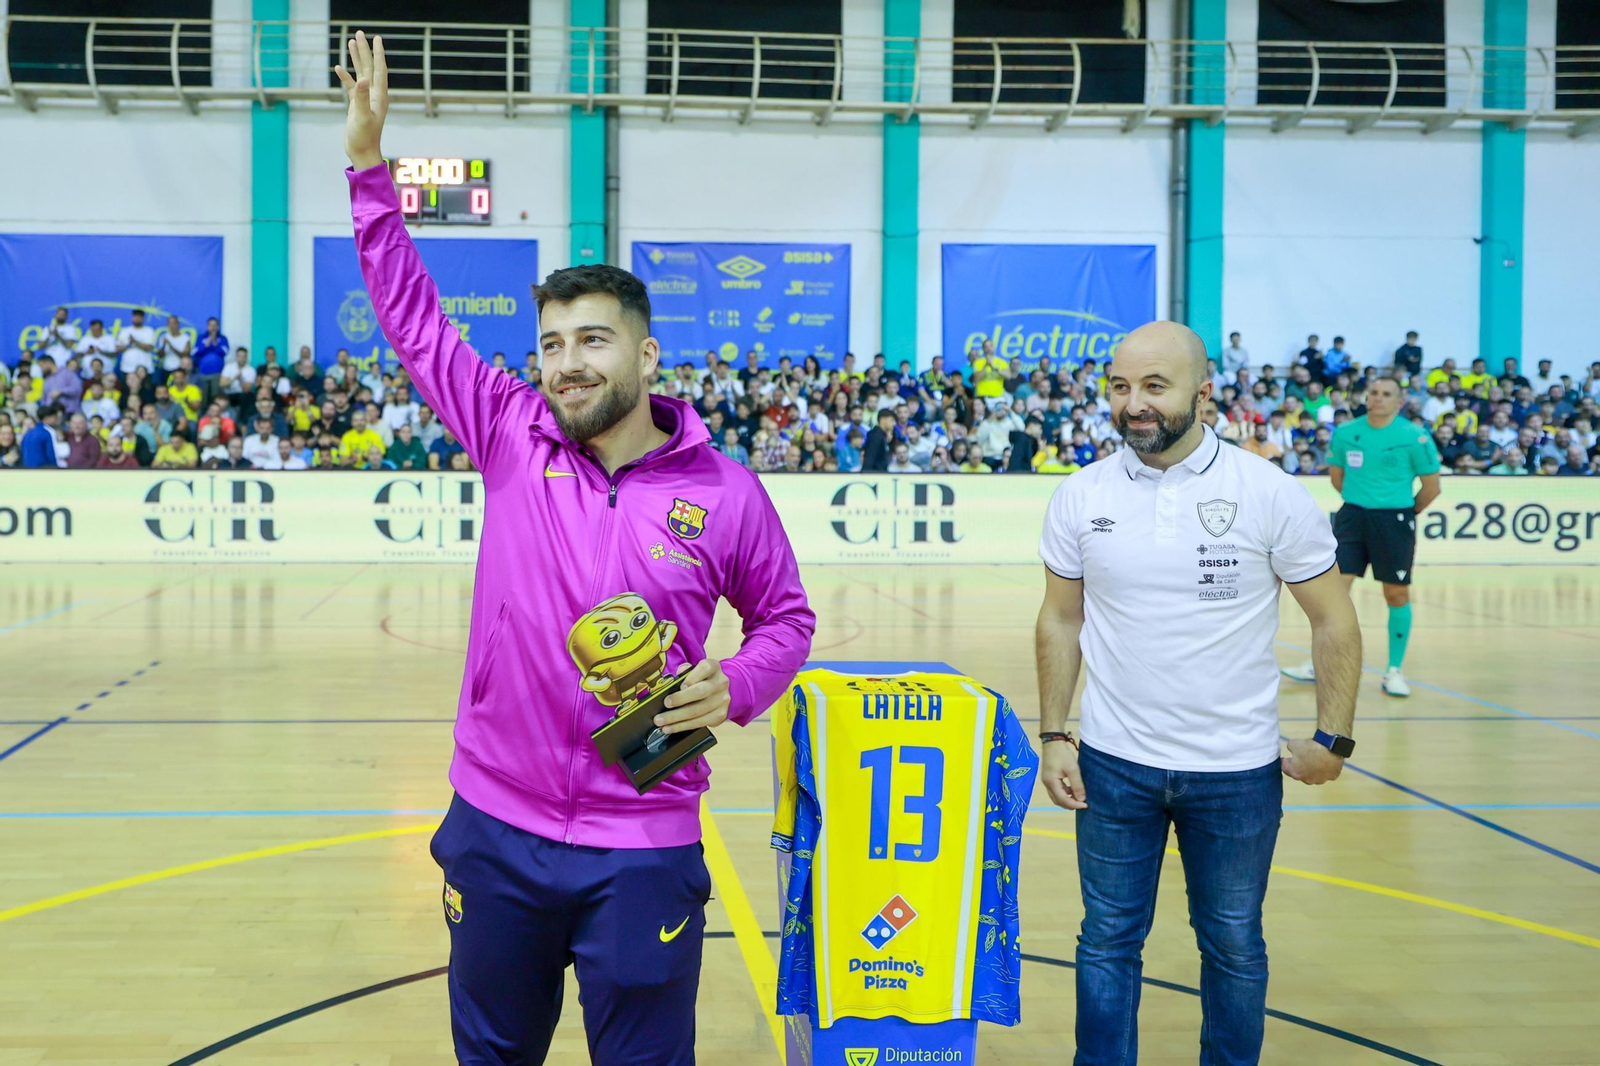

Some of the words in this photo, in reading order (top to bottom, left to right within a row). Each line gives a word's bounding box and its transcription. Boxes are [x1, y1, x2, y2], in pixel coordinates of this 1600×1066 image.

[396, 157, 464, 185] 20:00
[470, 160, 484, 178] 0
[401, 187, 419, 213] 0
[471, 188, 489, 215] 0
[721, 280, 762, 289] umbro
[440, 292, 517, 316] amiento
[1424, 503, 1600, 551] a28@g
[1198, 589, 1239, 598] eléctrica
[860, 745, 945, 863] 13
[849, 956, 924, 977] Domino's
[864, 974, 908, 991] Pizza
[885, 1047, 962, 1065] Diputación
